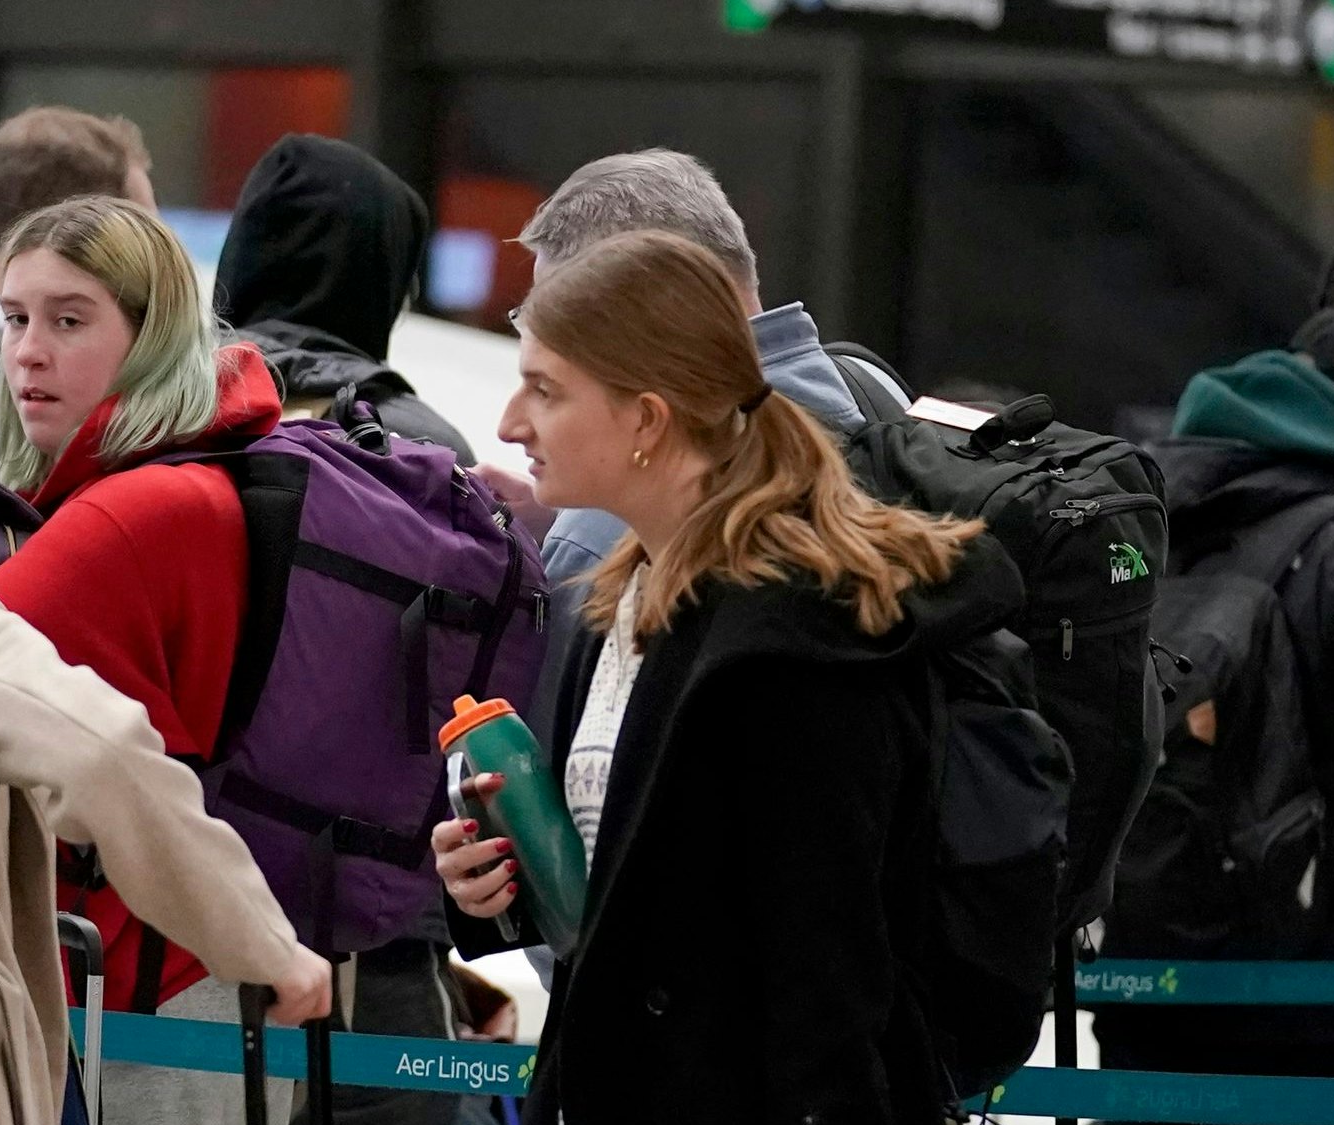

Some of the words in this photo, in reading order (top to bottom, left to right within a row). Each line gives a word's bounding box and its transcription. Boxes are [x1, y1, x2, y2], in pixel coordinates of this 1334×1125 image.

[1102, 971, 1154, 998] Lingus
[395, 1053, 436, 1077] Aer
[438, 1055, 510, 1088] Lingus
